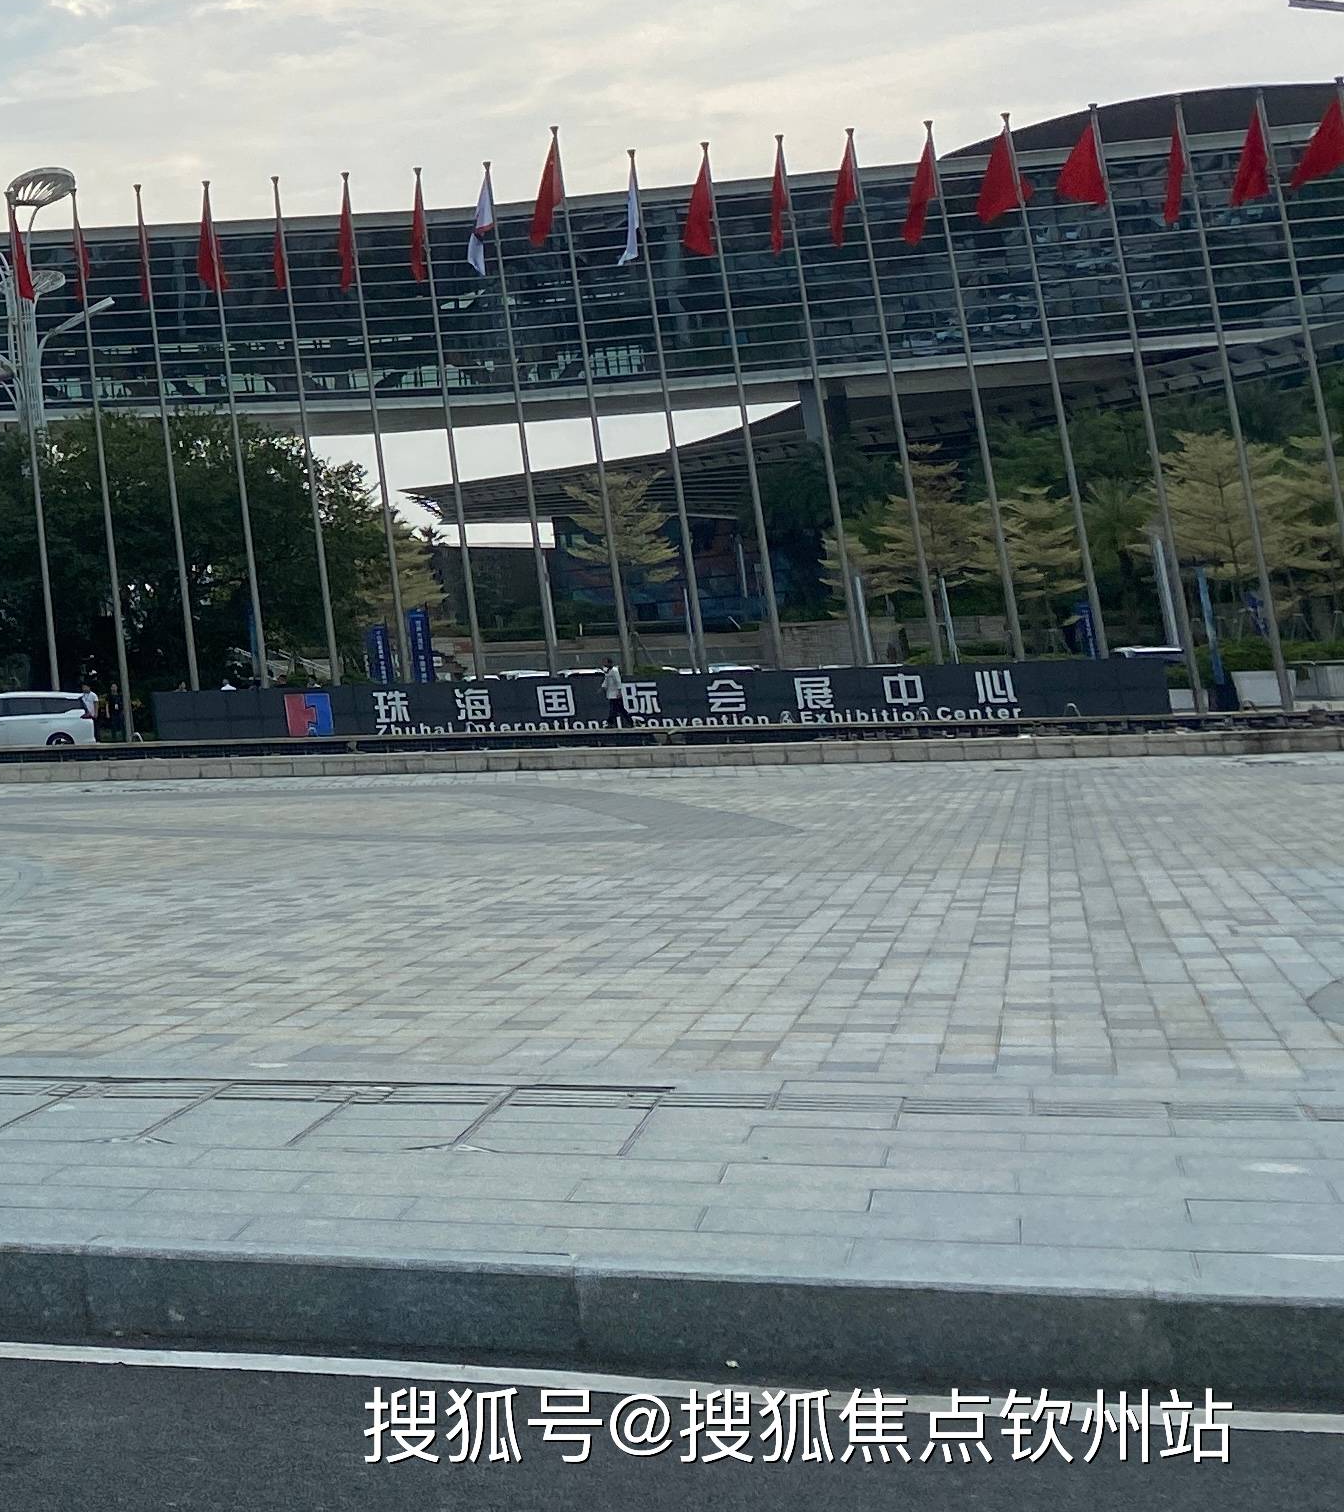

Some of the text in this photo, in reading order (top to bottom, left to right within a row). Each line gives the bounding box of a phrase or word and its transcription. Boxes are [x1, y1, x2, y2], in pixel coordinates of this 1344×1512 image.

[373, 670, 1018, 723] 珠海国际会展中心
[375, 721, 453, 736] Zhuhai
[631, 713, 770, 729] Convention
[799, 708, 928, 725] Exhibition
[936, 706, 1022, 721] Center
